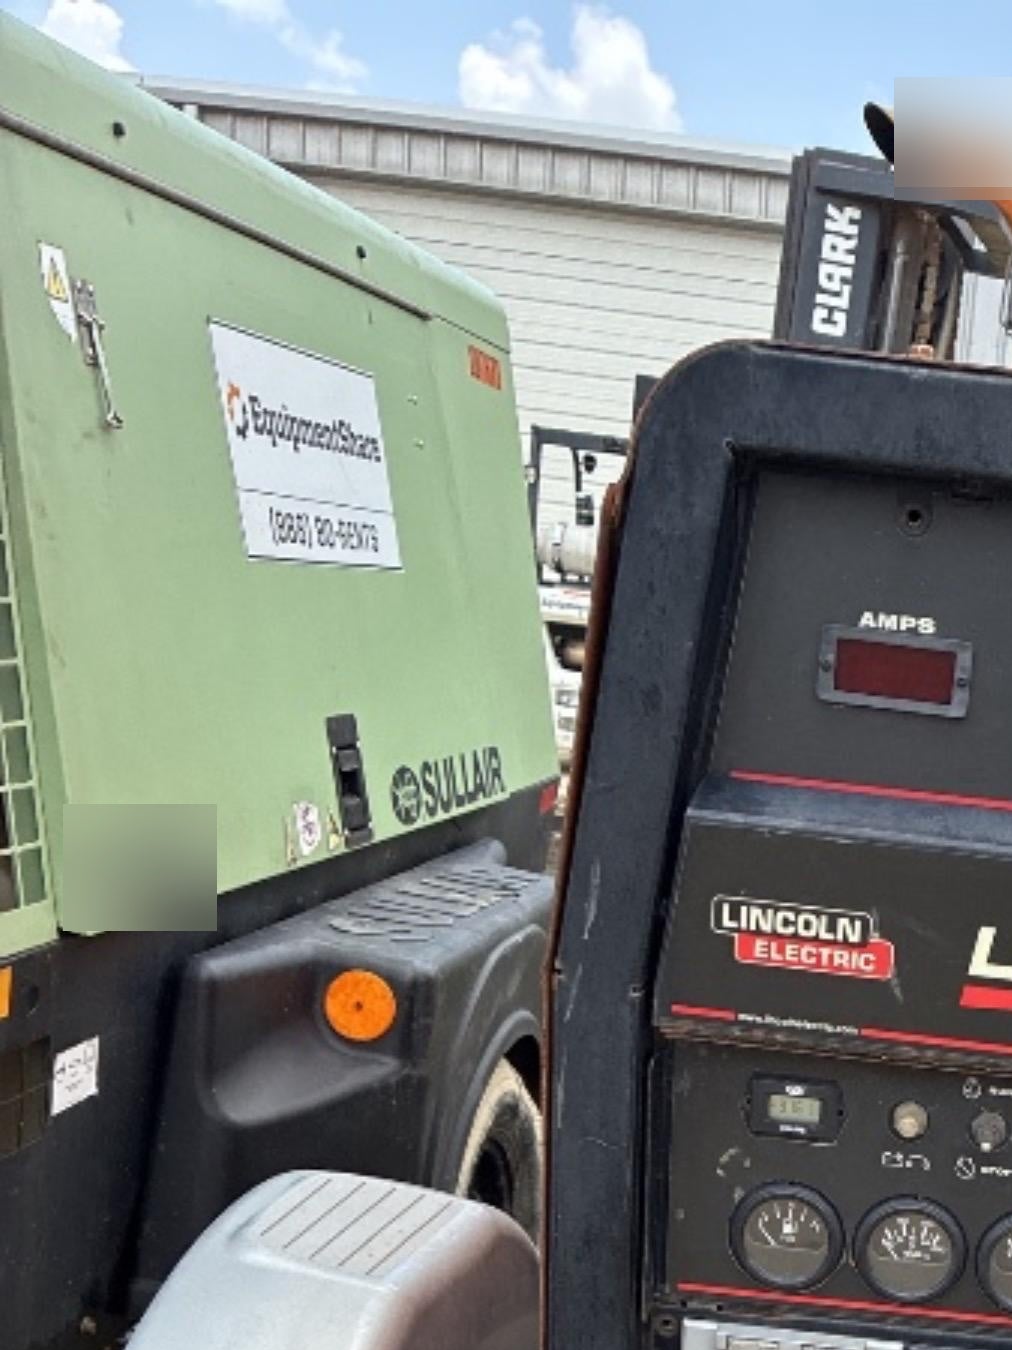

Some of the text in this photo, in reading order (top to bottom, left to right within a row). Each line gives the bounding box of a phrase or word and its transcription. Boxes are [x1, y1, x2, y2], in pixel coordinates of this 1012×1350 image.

[811, 203, 862, 338] CLARK
[248, 395, 382, 463] EquipmentShare
[858, 611, 937, 635] AMPS
[421, 746, 505, 818] SULLAIR
[721, 902, 862, 943] LINCOLN
[752, 939, 876, 972] ELECTRIC
